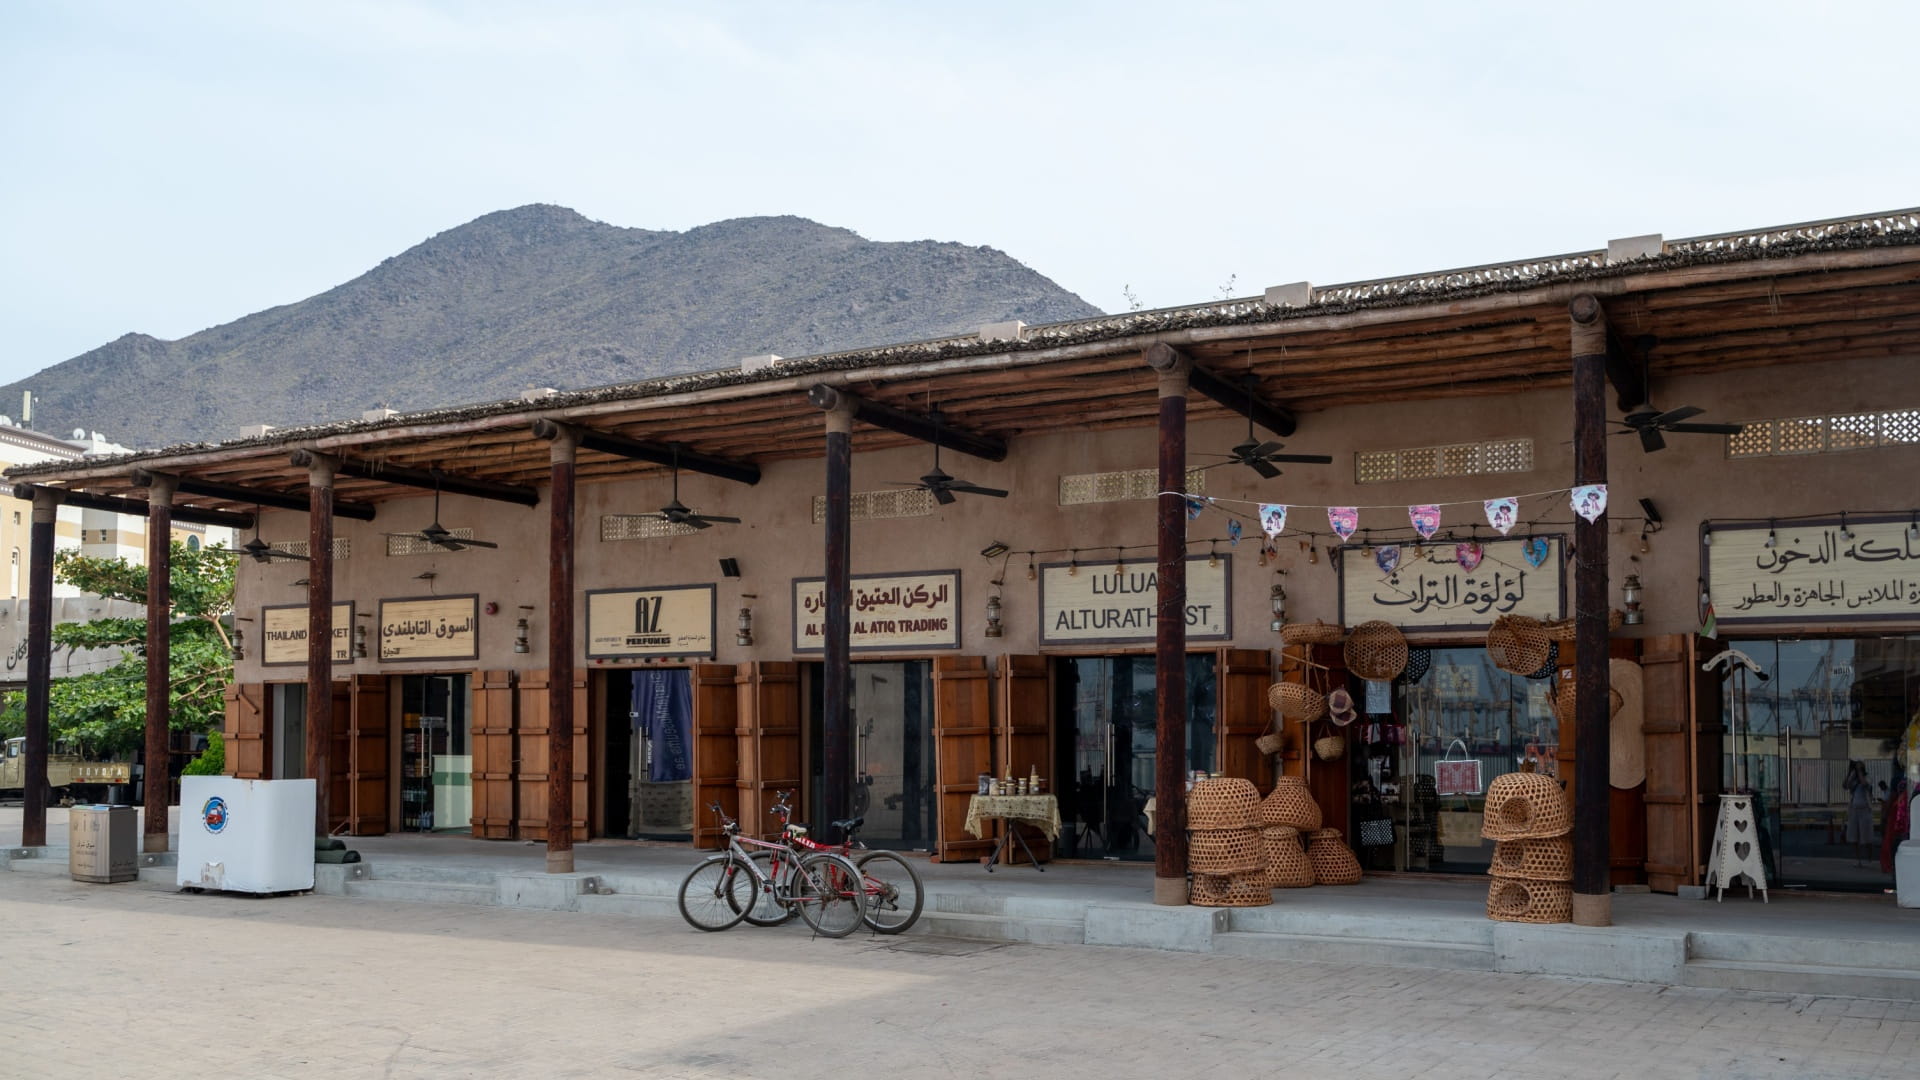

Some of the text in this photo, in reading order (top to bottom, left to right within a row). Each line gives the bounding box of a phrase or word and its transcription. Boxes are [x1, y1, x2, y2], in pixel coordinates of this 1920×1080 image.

[1756, 530, 1837, 573] الدخون
[903, 583, 948, 609] الركن
[1092, 572, 1159, 594] LULUA
[1373, 570, 1526, 615] لؤلؤة التراث
[1733, 581, 1790, 610] والعطور
[1794, 580, 1844, 608] الجاهزة
[1847, 579, 1904, 609] الملابس
[856, 586, 900, 612] العتيق
[635, 596, 663, 634] AZ
[805, 623, 818, 636] AL
[854, 621, 867, 634] AL
[870, 619, 896, 634] ATIQ
[898, 618, 948, 632] TRADING
[1184, 605, 1211, 626] ST
[266, 627, 349, 641] THAILAND KET
[383, 617, 474, 643] السوق التايلندي
[626, 637, 672, 646] PERFUMES
[79, 768, 122, 776] TOYOTA
